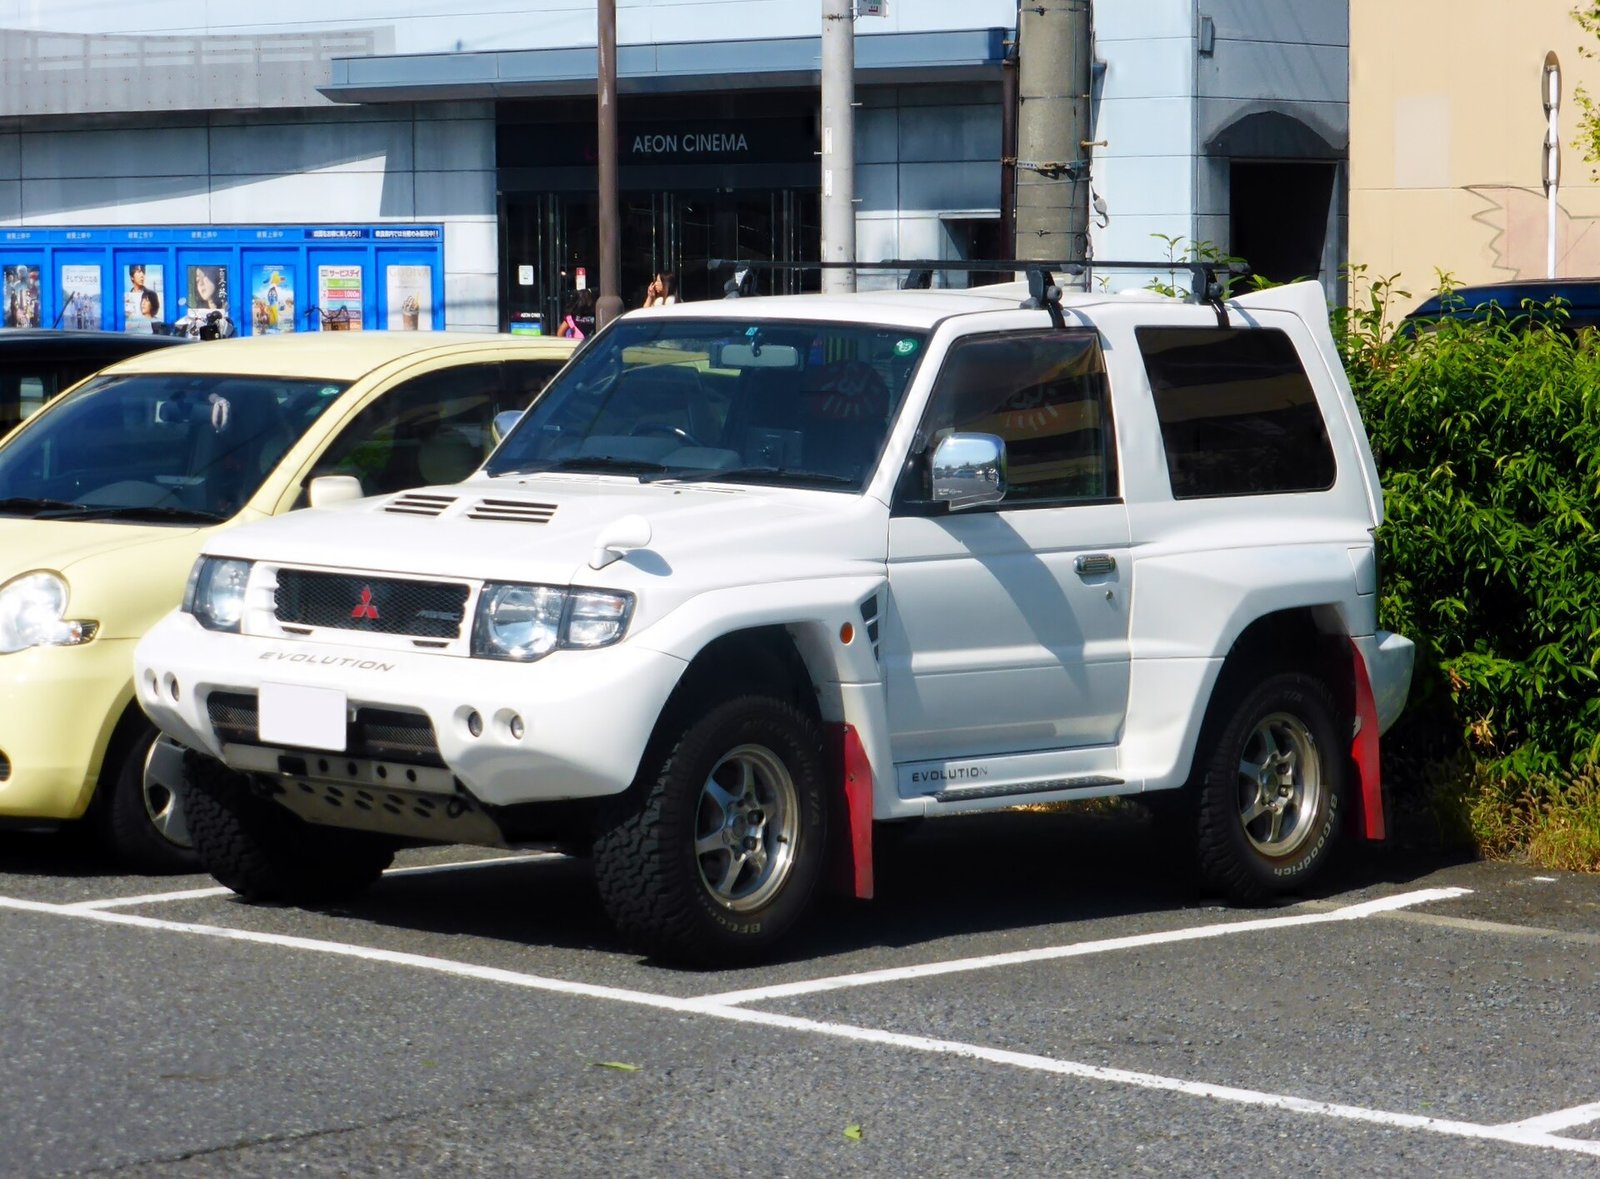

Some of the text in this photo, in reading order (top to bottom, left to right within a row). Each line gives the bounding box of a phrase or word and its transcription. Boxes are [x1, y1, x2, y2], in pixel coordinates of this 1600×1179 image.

[632, 133, 748, 153] AEON CINEMA
[258, 651, 396, 672] EVOLUTION
[911, 766, 988, 783] EVOLUTION
[1274, 793, 1338, 877] BFGoodrich
